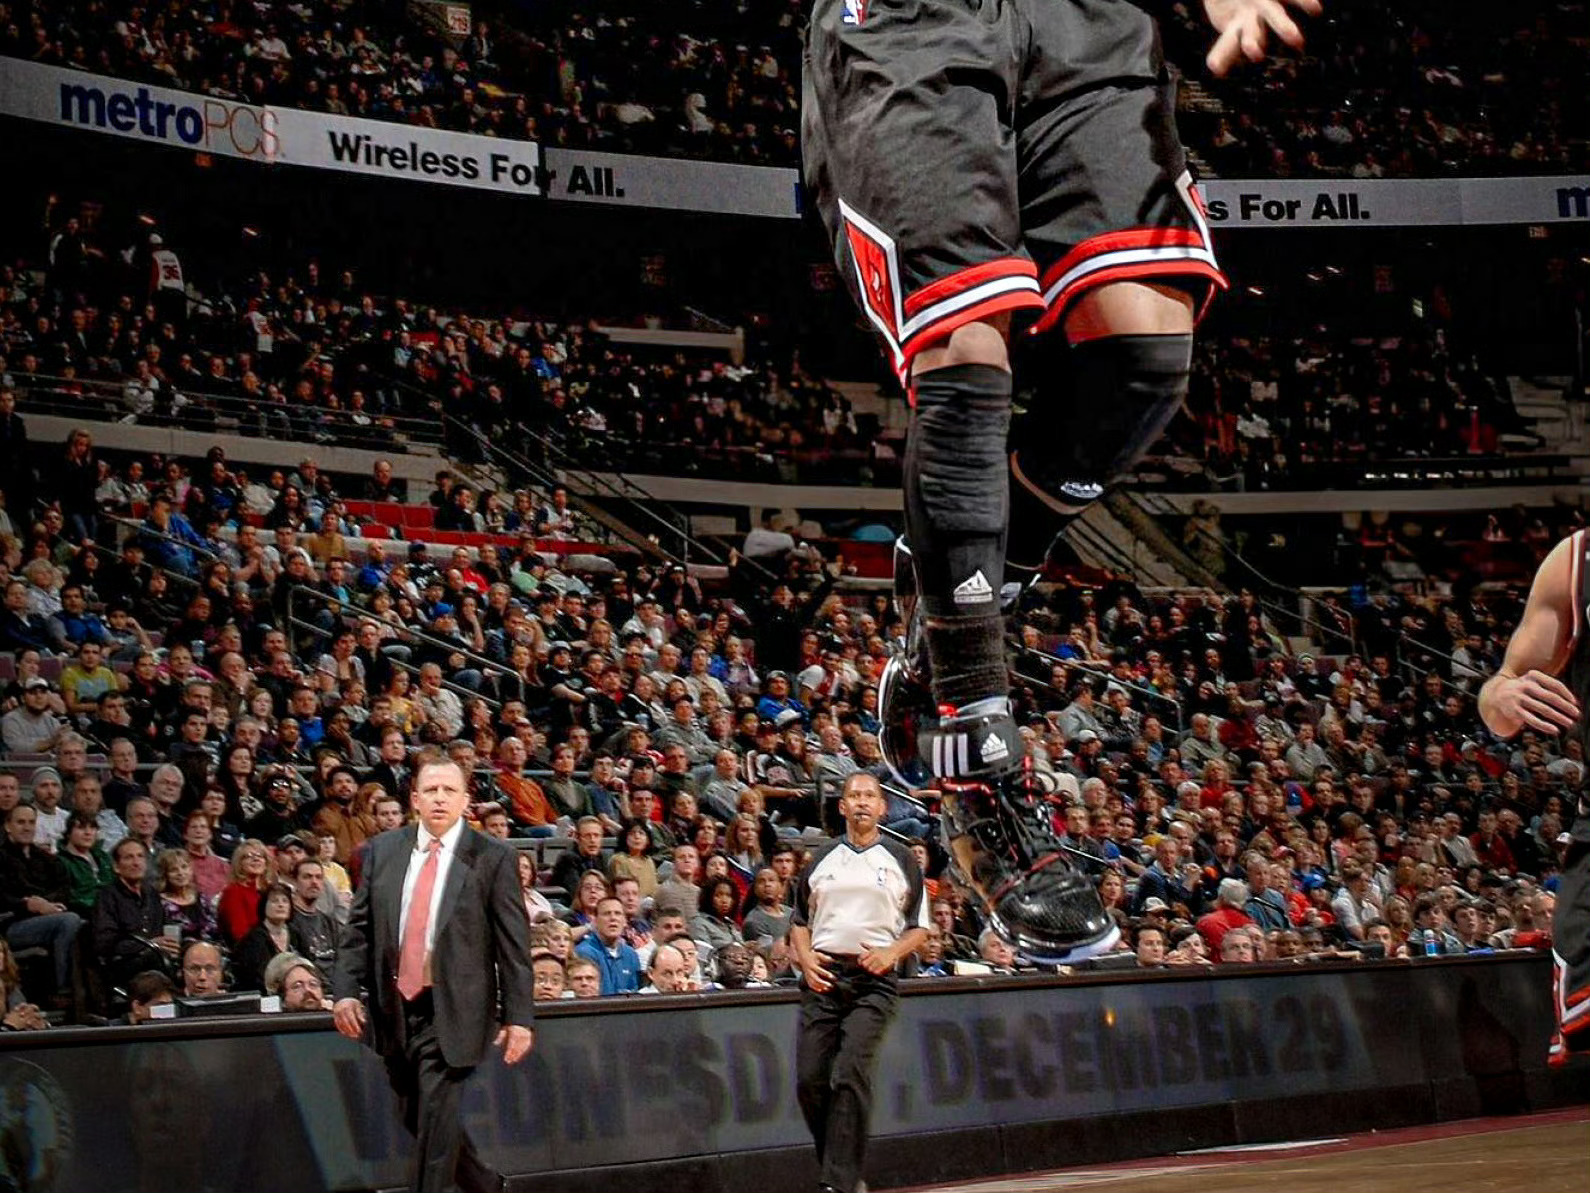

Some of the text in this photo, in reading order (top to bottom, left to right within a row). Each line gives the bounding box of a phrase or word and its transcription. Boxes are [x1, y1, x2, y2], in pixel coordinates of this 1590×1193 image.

[60, 82, 280, 156] metroPCS
[329, 131, 625, 197] Wireless For All.
[1240, 194, 1301, 221] For
[1311, 193, 1371, 220] All.
[919, 1002, 1273, 1107] DECEMBER
[1274, 994, 1348, 1073] 29
